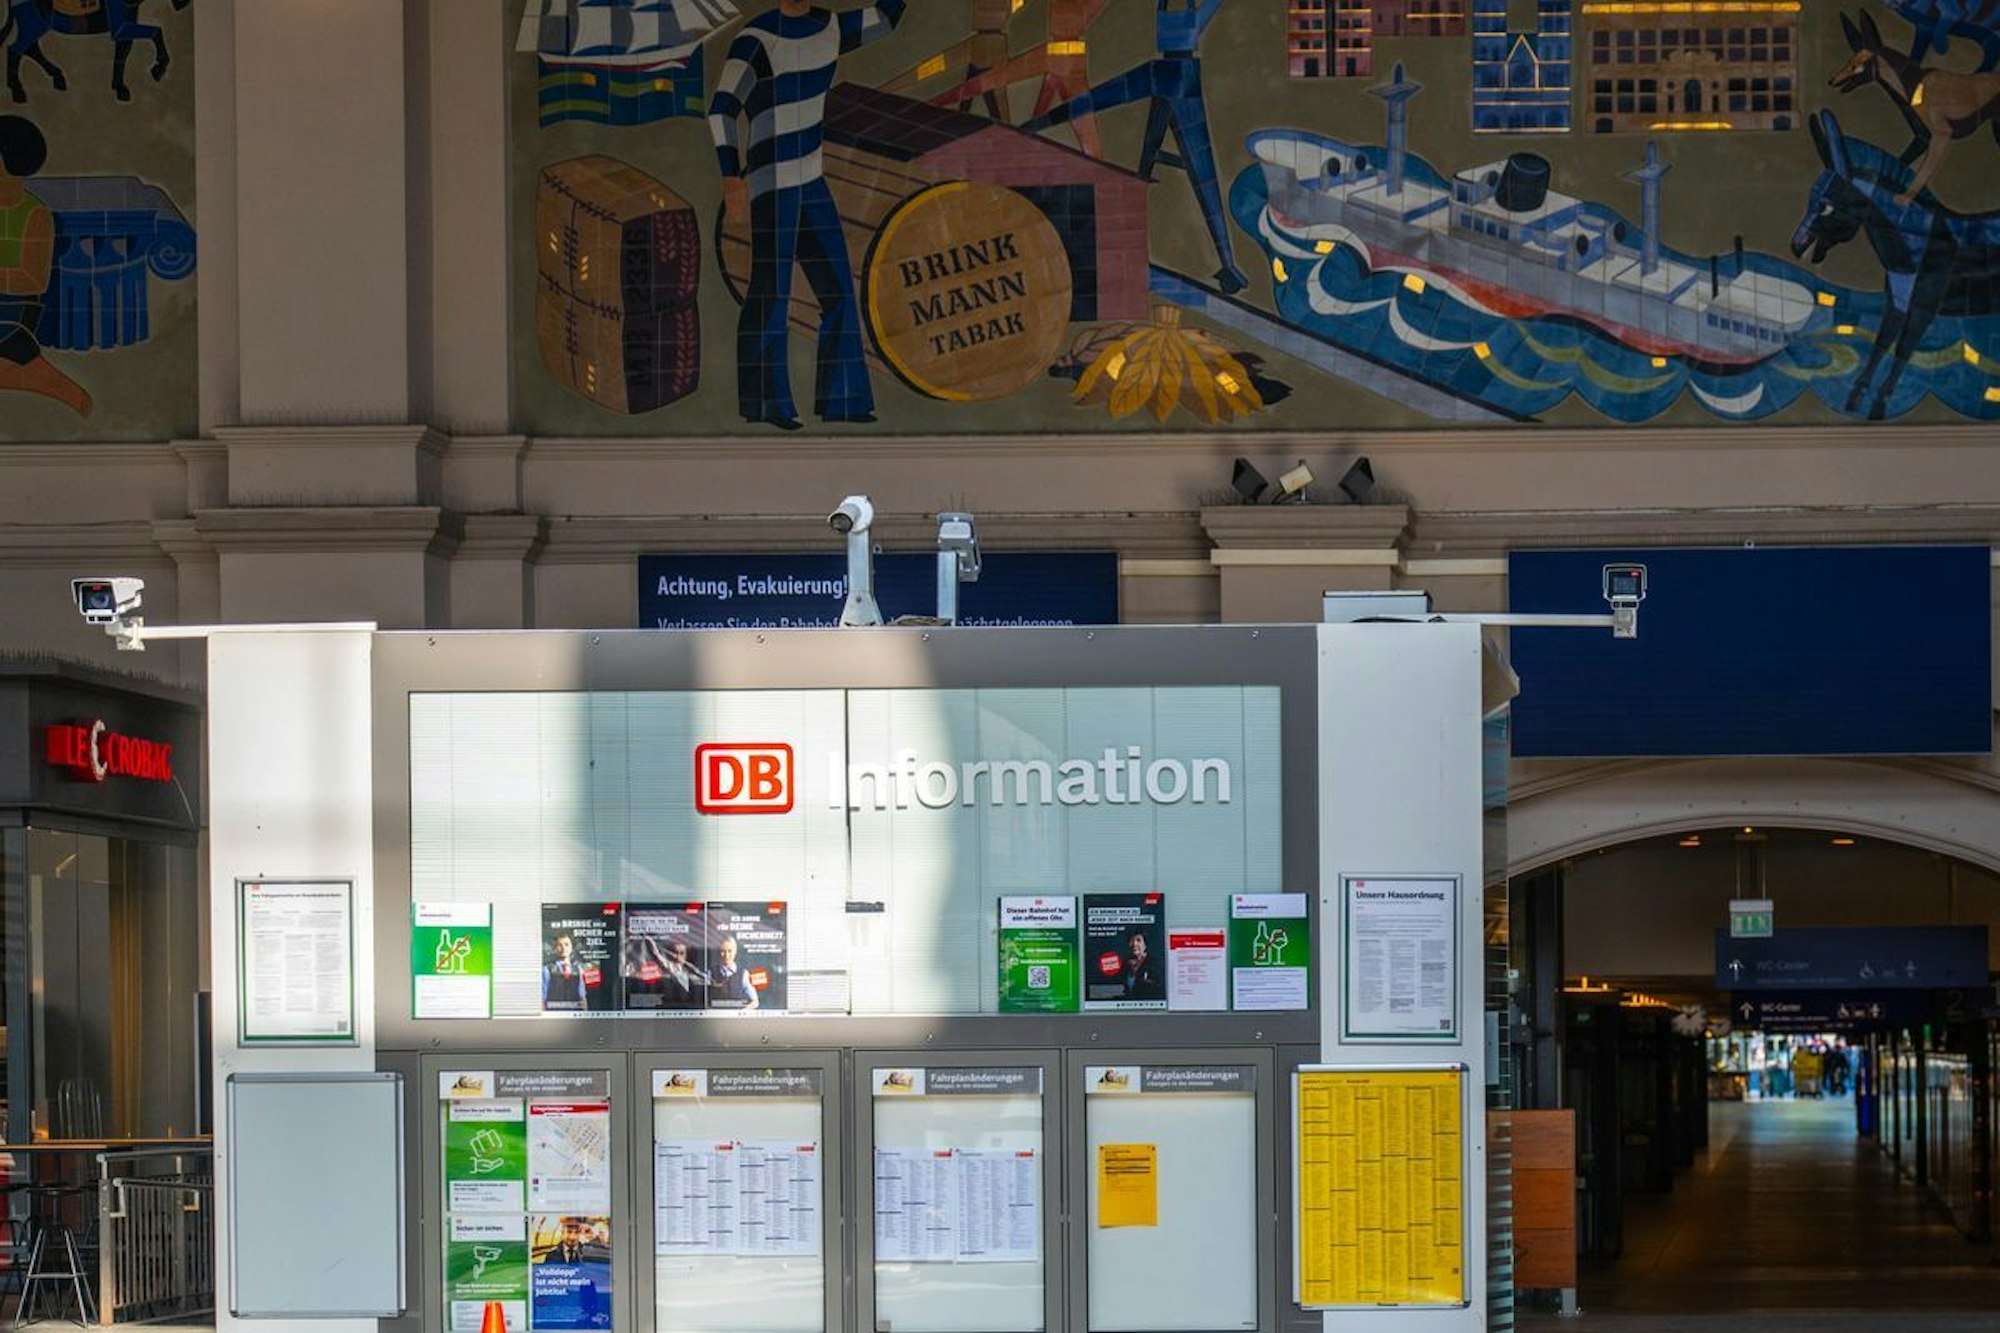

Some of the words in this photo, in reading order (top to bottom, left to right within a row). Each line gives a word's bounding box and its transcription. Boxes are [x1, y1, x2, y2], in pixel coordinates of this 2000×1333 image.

[899, 233, 1019, 288] BRINK
[909, 271, 1026, 326] MANN
[929, 312, 1024, 355] TABAK
[657, 575, 733, 599] Achtung,
[738, 574, 848, 599] Evakuierung!
[64, 725, 89, 767] LE
[708, 754, 784, 801] DB
[828, 746, 1232, 810] Information
[1356, 891, 1386, 899] Unsere
[1388, 890, 1445, 901] Hausordnung
[500, 1075, 593, 1087] Fahrplanänderungen
[712, 1074, 806, 1086] Fahrplanänderungen
[931, 1073, 1024, 1084] Fahrplanänderungen
[1146, 1071, 1239, 1082] Fahrplanänderungen
[547, 1278, 569, 1286] nicht
